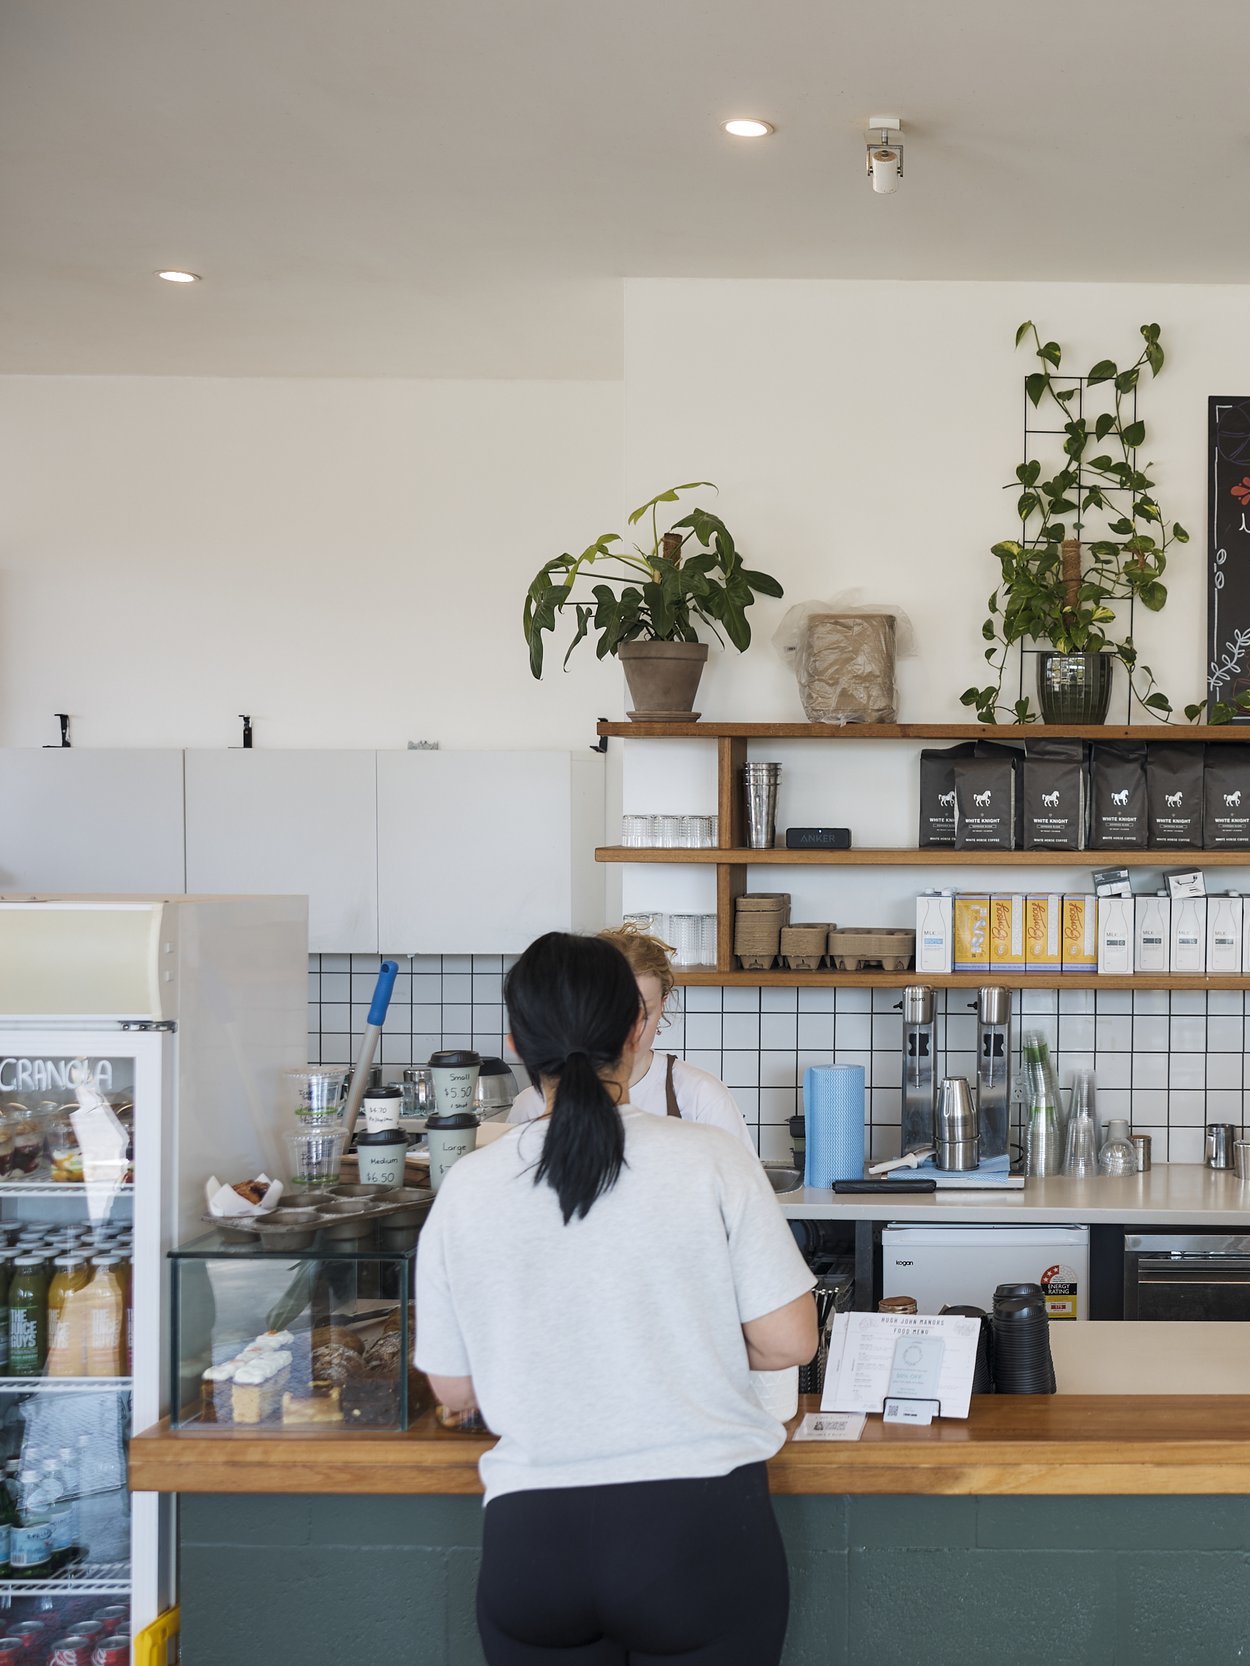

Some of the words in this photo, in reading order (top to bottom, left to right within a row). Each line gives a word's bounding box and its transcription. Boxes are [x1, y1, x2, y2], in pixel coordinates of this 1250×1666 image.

[801, 834, 835, 842] ANKER
[450, 1073, 470, 1082] Small
[444, 1086, 472, 1098] $5.50
[443, 1142, 466, 1155] Large
[367, 1172, 395, 1182] $6.50
[10, 1309, 27, 1322] THE
[10, 1321, 37, 1334] JUICE
[10, 1334, 37, 1348] GUYS
